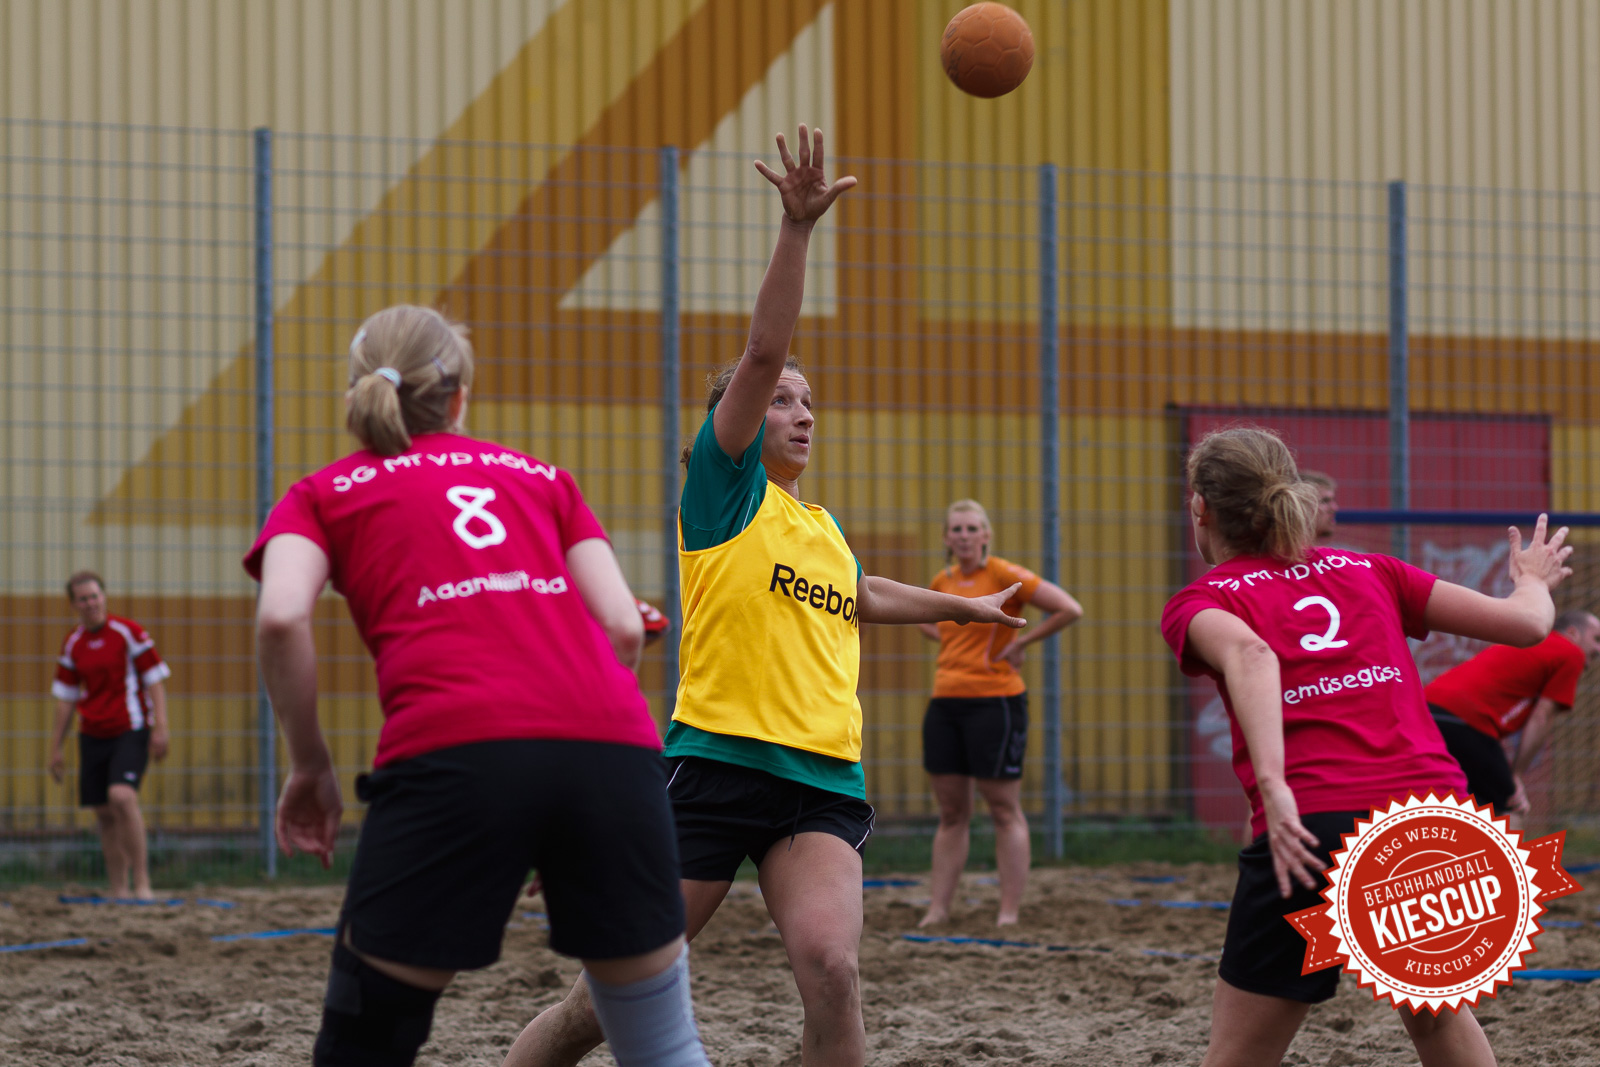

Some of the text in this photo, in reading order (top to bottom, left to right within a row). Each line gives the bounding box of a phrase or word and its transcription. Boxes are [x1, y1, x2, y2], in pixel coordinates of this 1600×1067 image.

[333, 465, 377, 493] SG
[446, 485, 507, 550] 8
[1293, 595, 1349, 651] 2
